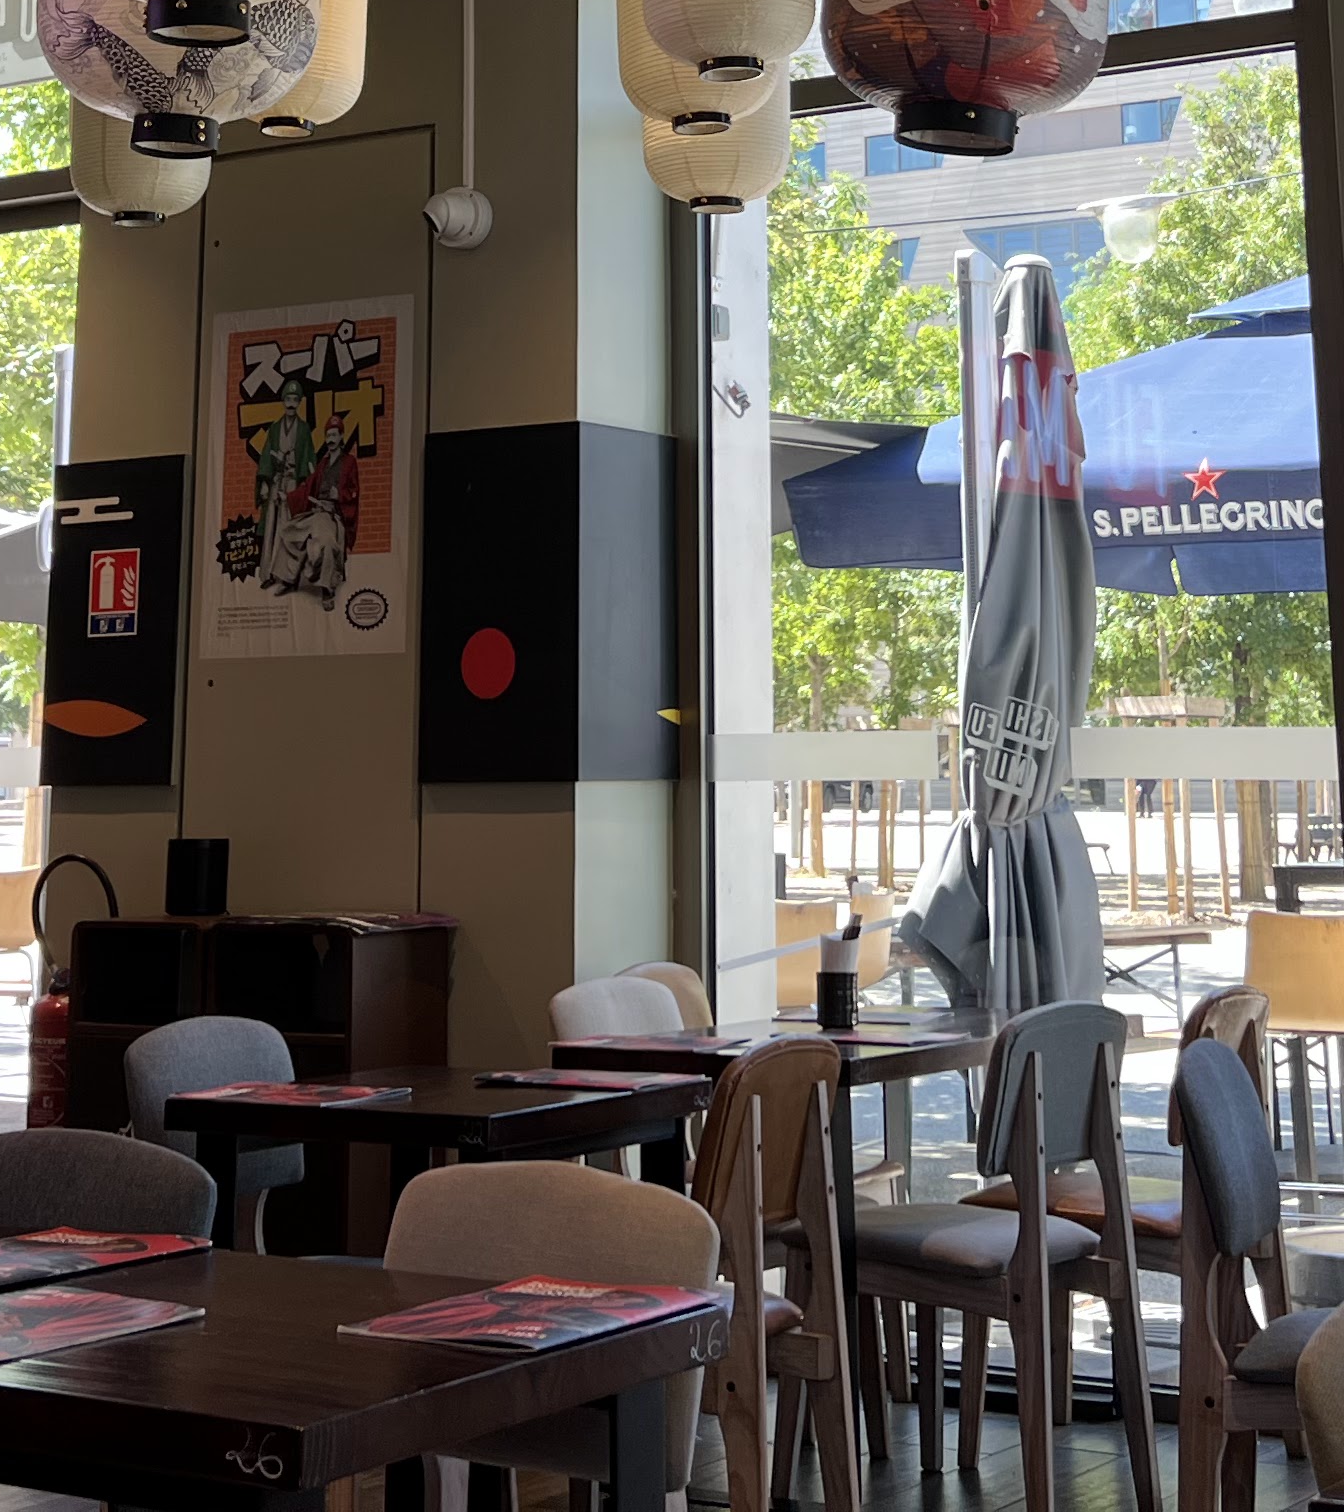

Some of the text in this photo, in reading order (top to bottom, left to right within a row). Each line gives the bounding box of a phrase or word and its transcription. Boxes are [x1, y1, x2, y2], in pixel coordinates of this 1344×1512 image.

[240, 319, 380, 399] スーパー
[689, 1319, 722, 1363] 26
[225, 1425, 284, 1480] 26
